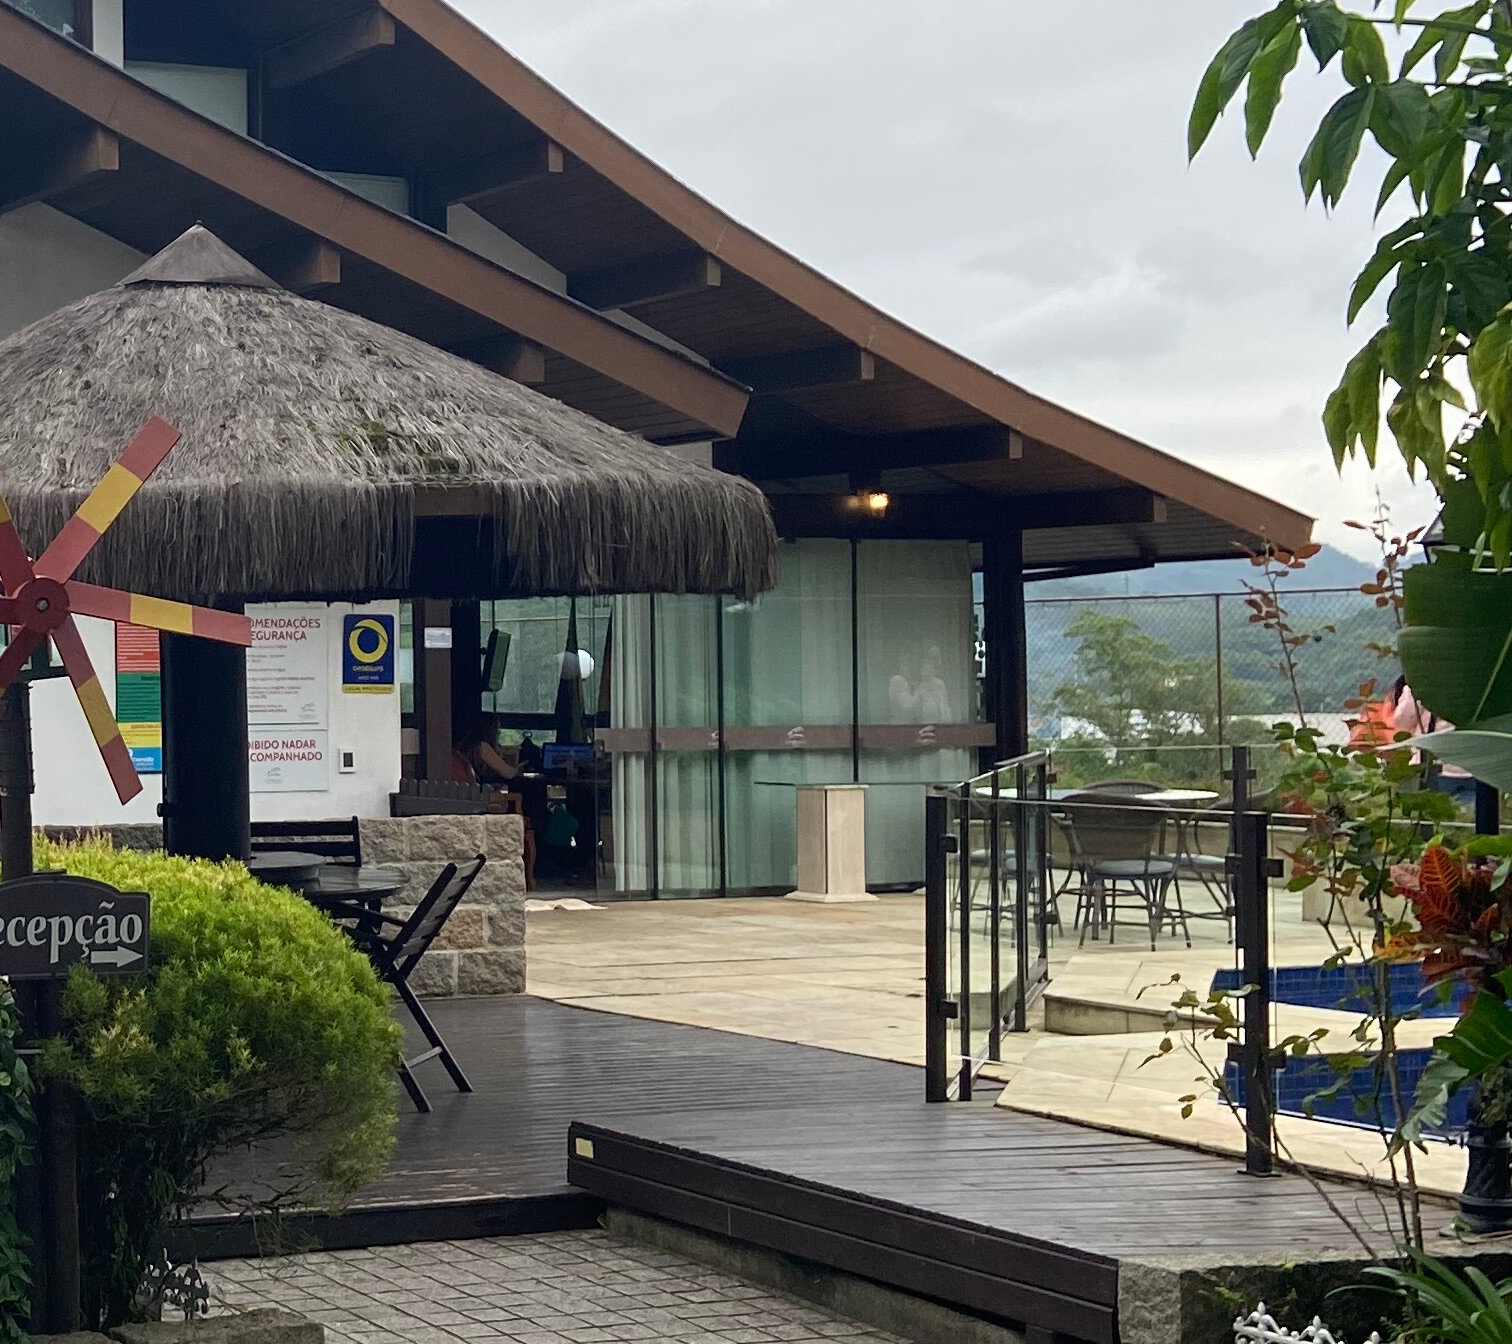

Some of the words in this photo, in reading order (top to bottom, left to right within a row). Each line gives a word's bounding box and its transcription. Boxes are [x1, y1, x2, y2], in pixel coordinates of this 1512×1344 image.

[251, 630, 307, 642] EGURANÇA
[282, 739, 317, 749] NADAR
[249, 751, 323, 762] COMPANHADO
